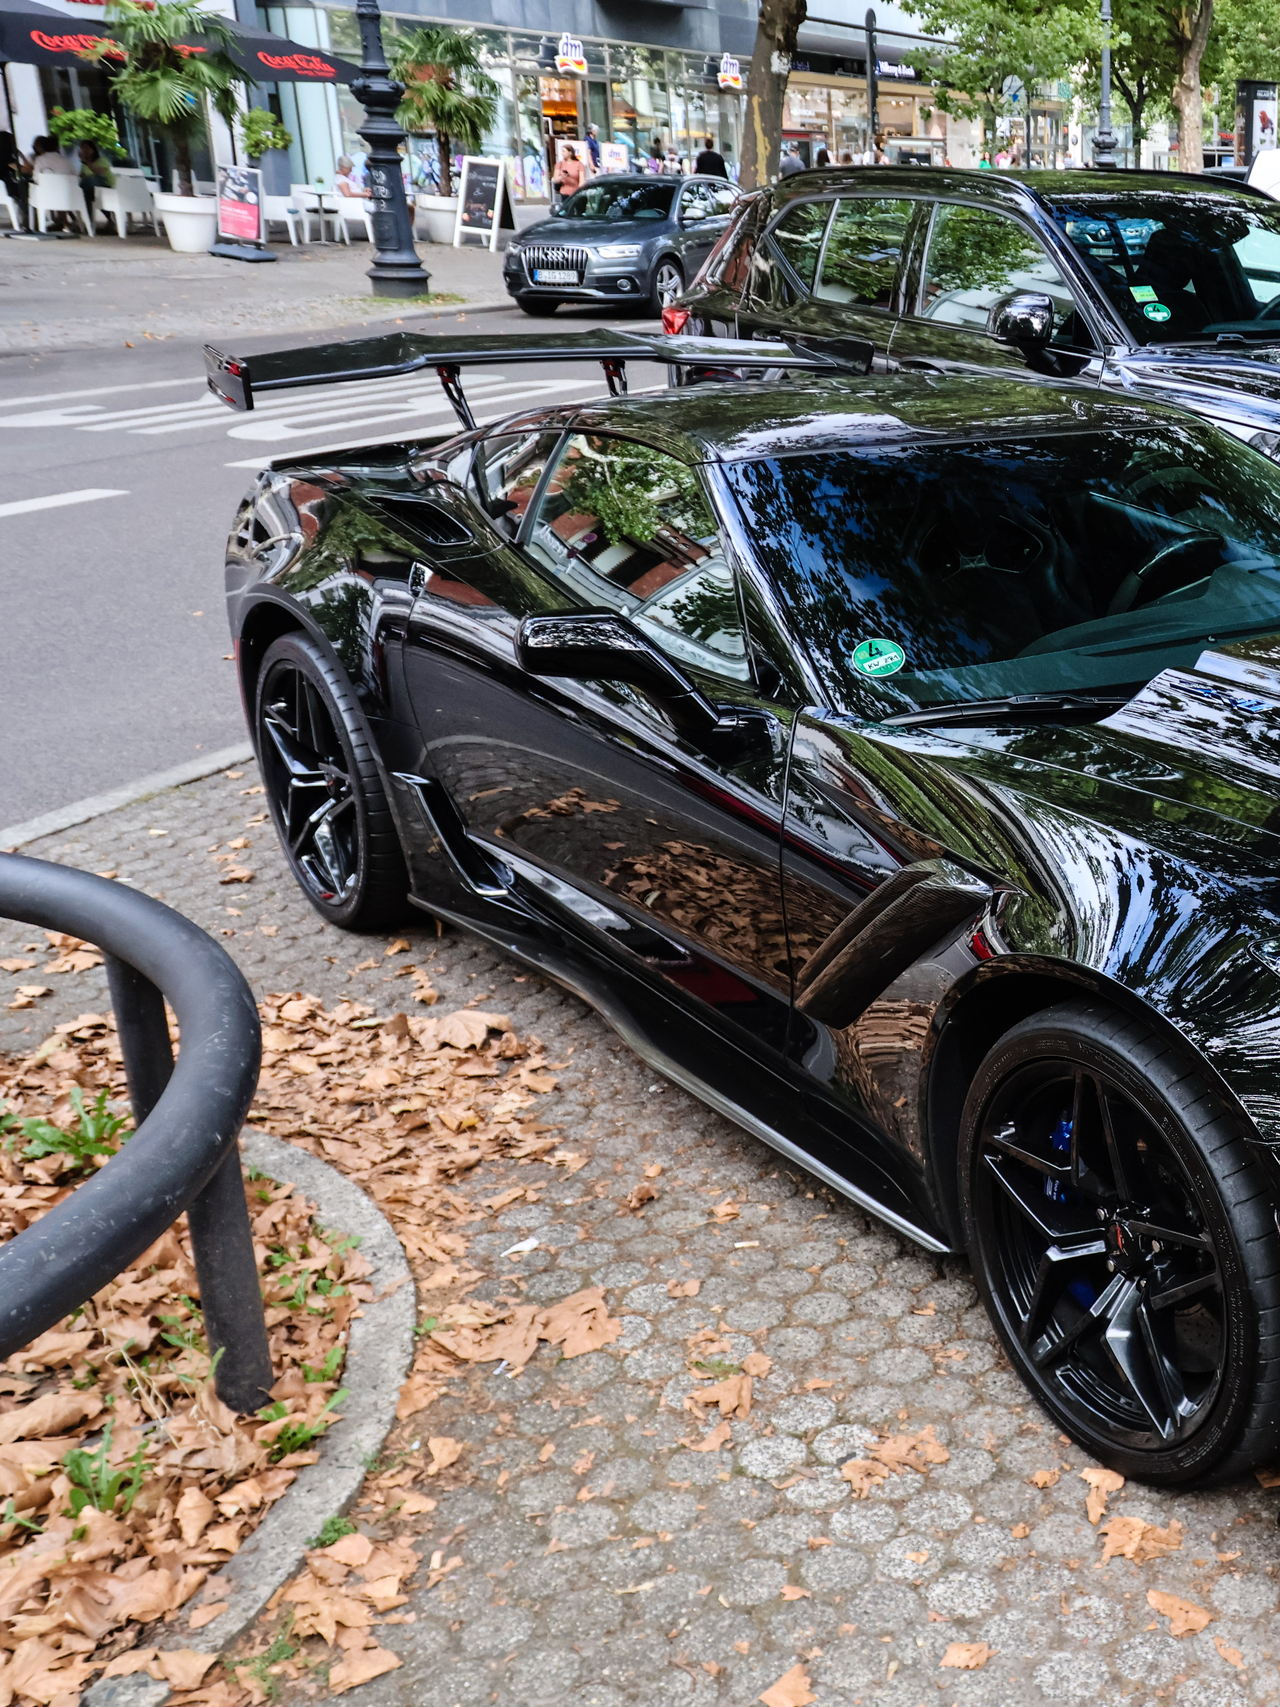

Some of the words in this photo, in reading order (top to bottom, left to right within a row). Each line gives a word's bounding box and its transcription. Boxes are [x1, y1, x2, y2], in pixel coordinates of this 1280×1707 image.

[562, 34, 582, 57] dm
[257, 51, 337, 74] Coca-Cola
[722, 53, 739, 74] dm
[608, 148, 621, 158] dm
[537, 270, 543, 279] B
[558, 271, 576, 281] 1289
[868, 642, 883, 658] 4
